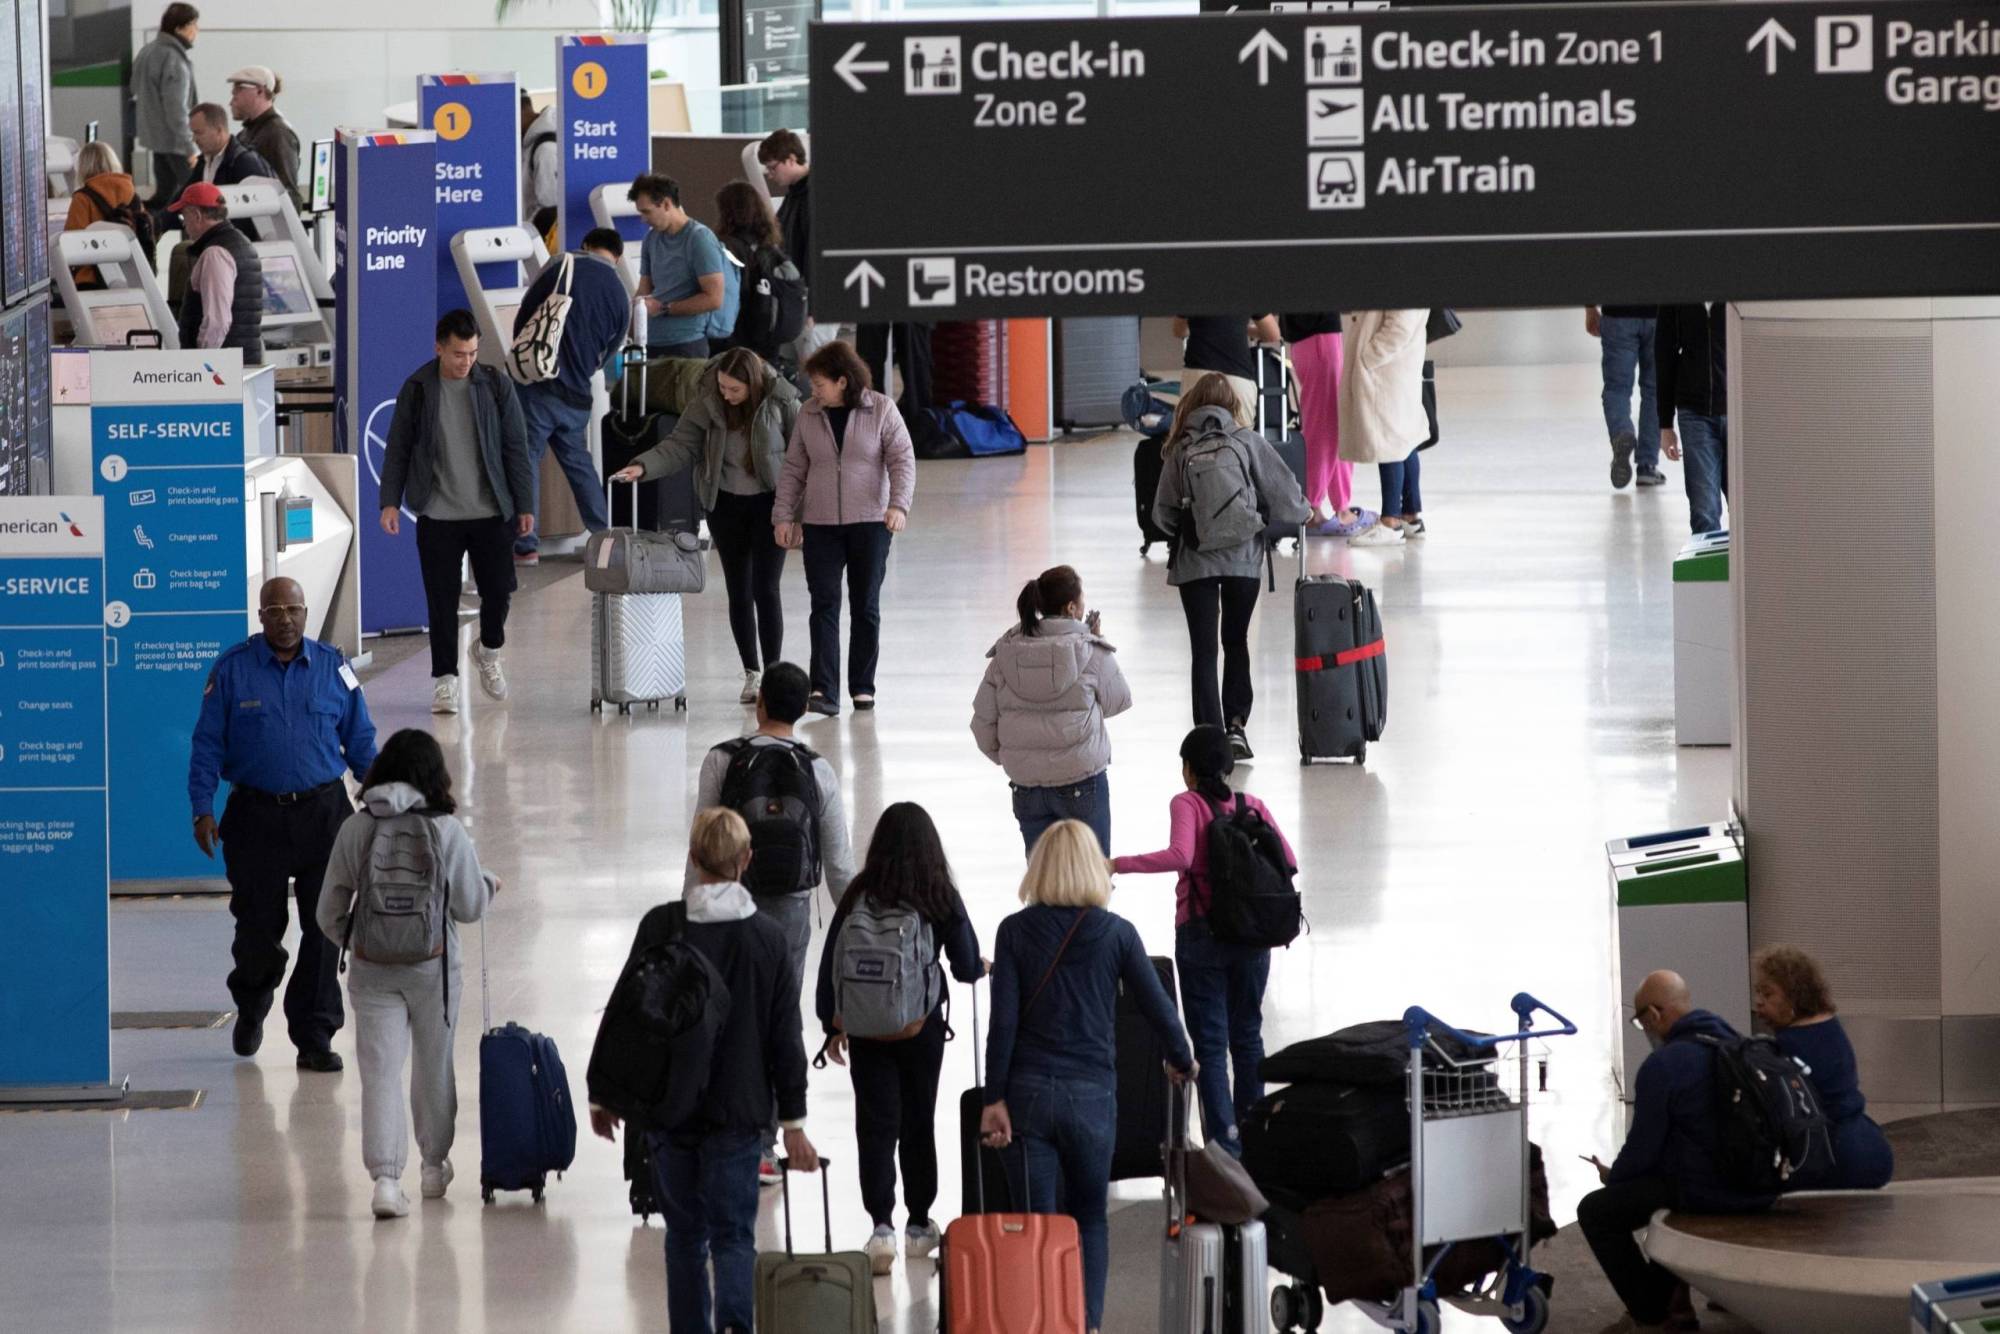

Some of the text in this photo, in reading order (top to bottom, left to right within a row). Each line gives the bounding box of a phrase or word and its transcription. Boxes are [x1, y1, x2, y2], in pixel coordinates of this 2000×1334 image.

[1371, 29, 1662, 70] Check-in Zone 1
[1830, 22, 1860, 67] P
[971, 41, 1145, 81] Check-in
[584, 72, 593, 89] 1
[974, 91, 1087, 127] Zone 2
[1372, 89, 1637, 132] All Terminals
[446, 112, 455, 131] 1
[574, 120, 617, 137] Start
[574, 143, 618, 160] Here
[435, 162, 482, 180] Start
[1376, 155, 1536, 195] AirTrain
[435, 186, 483, 204] Here
[366, 224, 427, 248] Priority
[366, 253, 405, 271] Lane
[965, 263, 1145, 297] Restrooms
[133, 370, 202, 384] American
[108, 421, 232, 439] SELF-SERVICE
[111, 464, 117, 478] 1
[168, 486, 216, 495] Check-in and
[168, 496, 239, 506] print boarding pass
[169, 533, 218, 543] Change seats
[169, 569, 227, 579] Check bags and
[170, 580, 220, 590] print bag tags
[114, 611, 121, 623] 2
[18, 648, 72, 657] Check-in and
[141, 641, 174, 651] checking
[196, 641, 220, 650] please
[135, 652, 165, 661] proceed
[177, 651, 194, 659] BAG
[196, 650, 220, 658] DROP
[18, 660, 96, 670] print boarding pass
[135, 661, 202, 672] after tagging bags
[18, 701, 73, 711] Change seats
[19, 741, 83, 751] Check bags and
[19, 753, 75, 763] print bag tags
[48, 821, 75, 830] please
[16, 832, 25, 840] to
[26, 831, 46, 840] BAG
[47, 831, 73, 839] DROP
[2, 843, 54, 854] tagging bags
